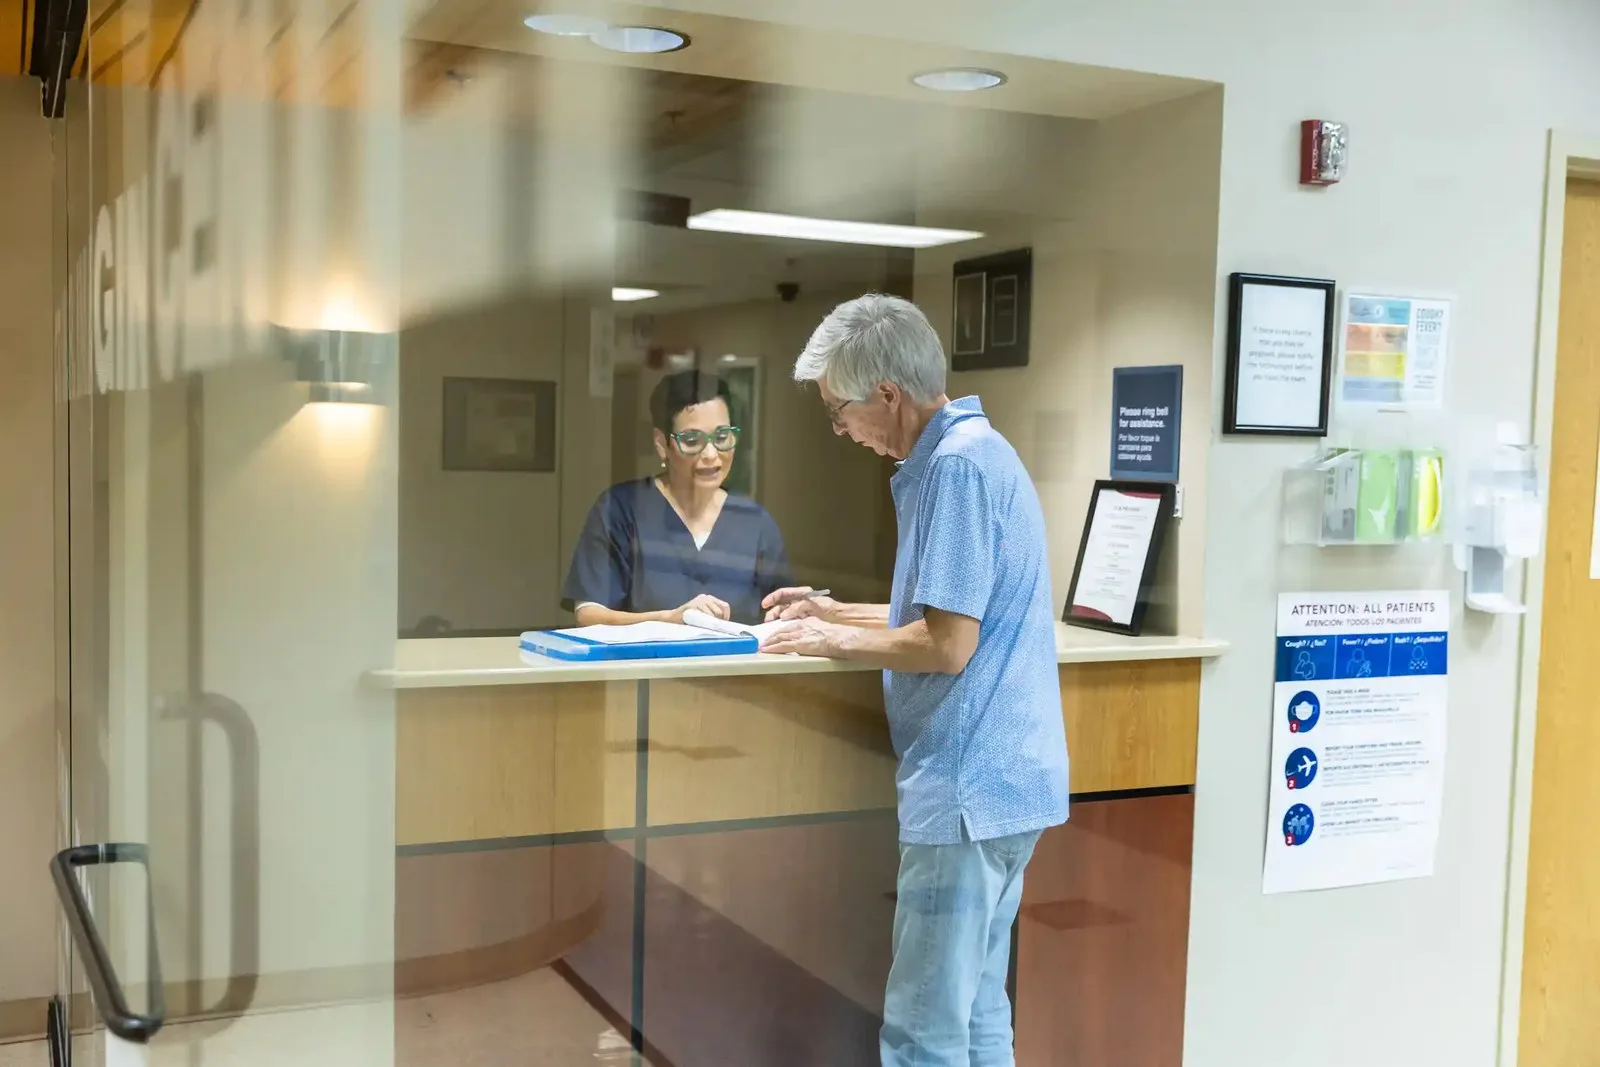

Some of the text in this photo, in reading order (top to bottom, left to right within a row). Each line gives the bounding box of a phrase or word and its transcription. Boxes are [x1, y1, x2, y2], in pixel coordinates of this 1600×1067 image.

[1120, 406, 1169, 418] Please ring bell
[1119, 418, 1166, 428] for assistance.
[1291, 602, 1435, 616] ATTENTION: ALL PATIENTS
[1346, 618, 1369, 626] TODOS
[1371, 618, 1385, 626] LOS
[1387, 616, 1422, 625] PACIENTES
[1285, 640, 1306, 649] Cough?
[1342, 638, 1360, 646] Fever?
